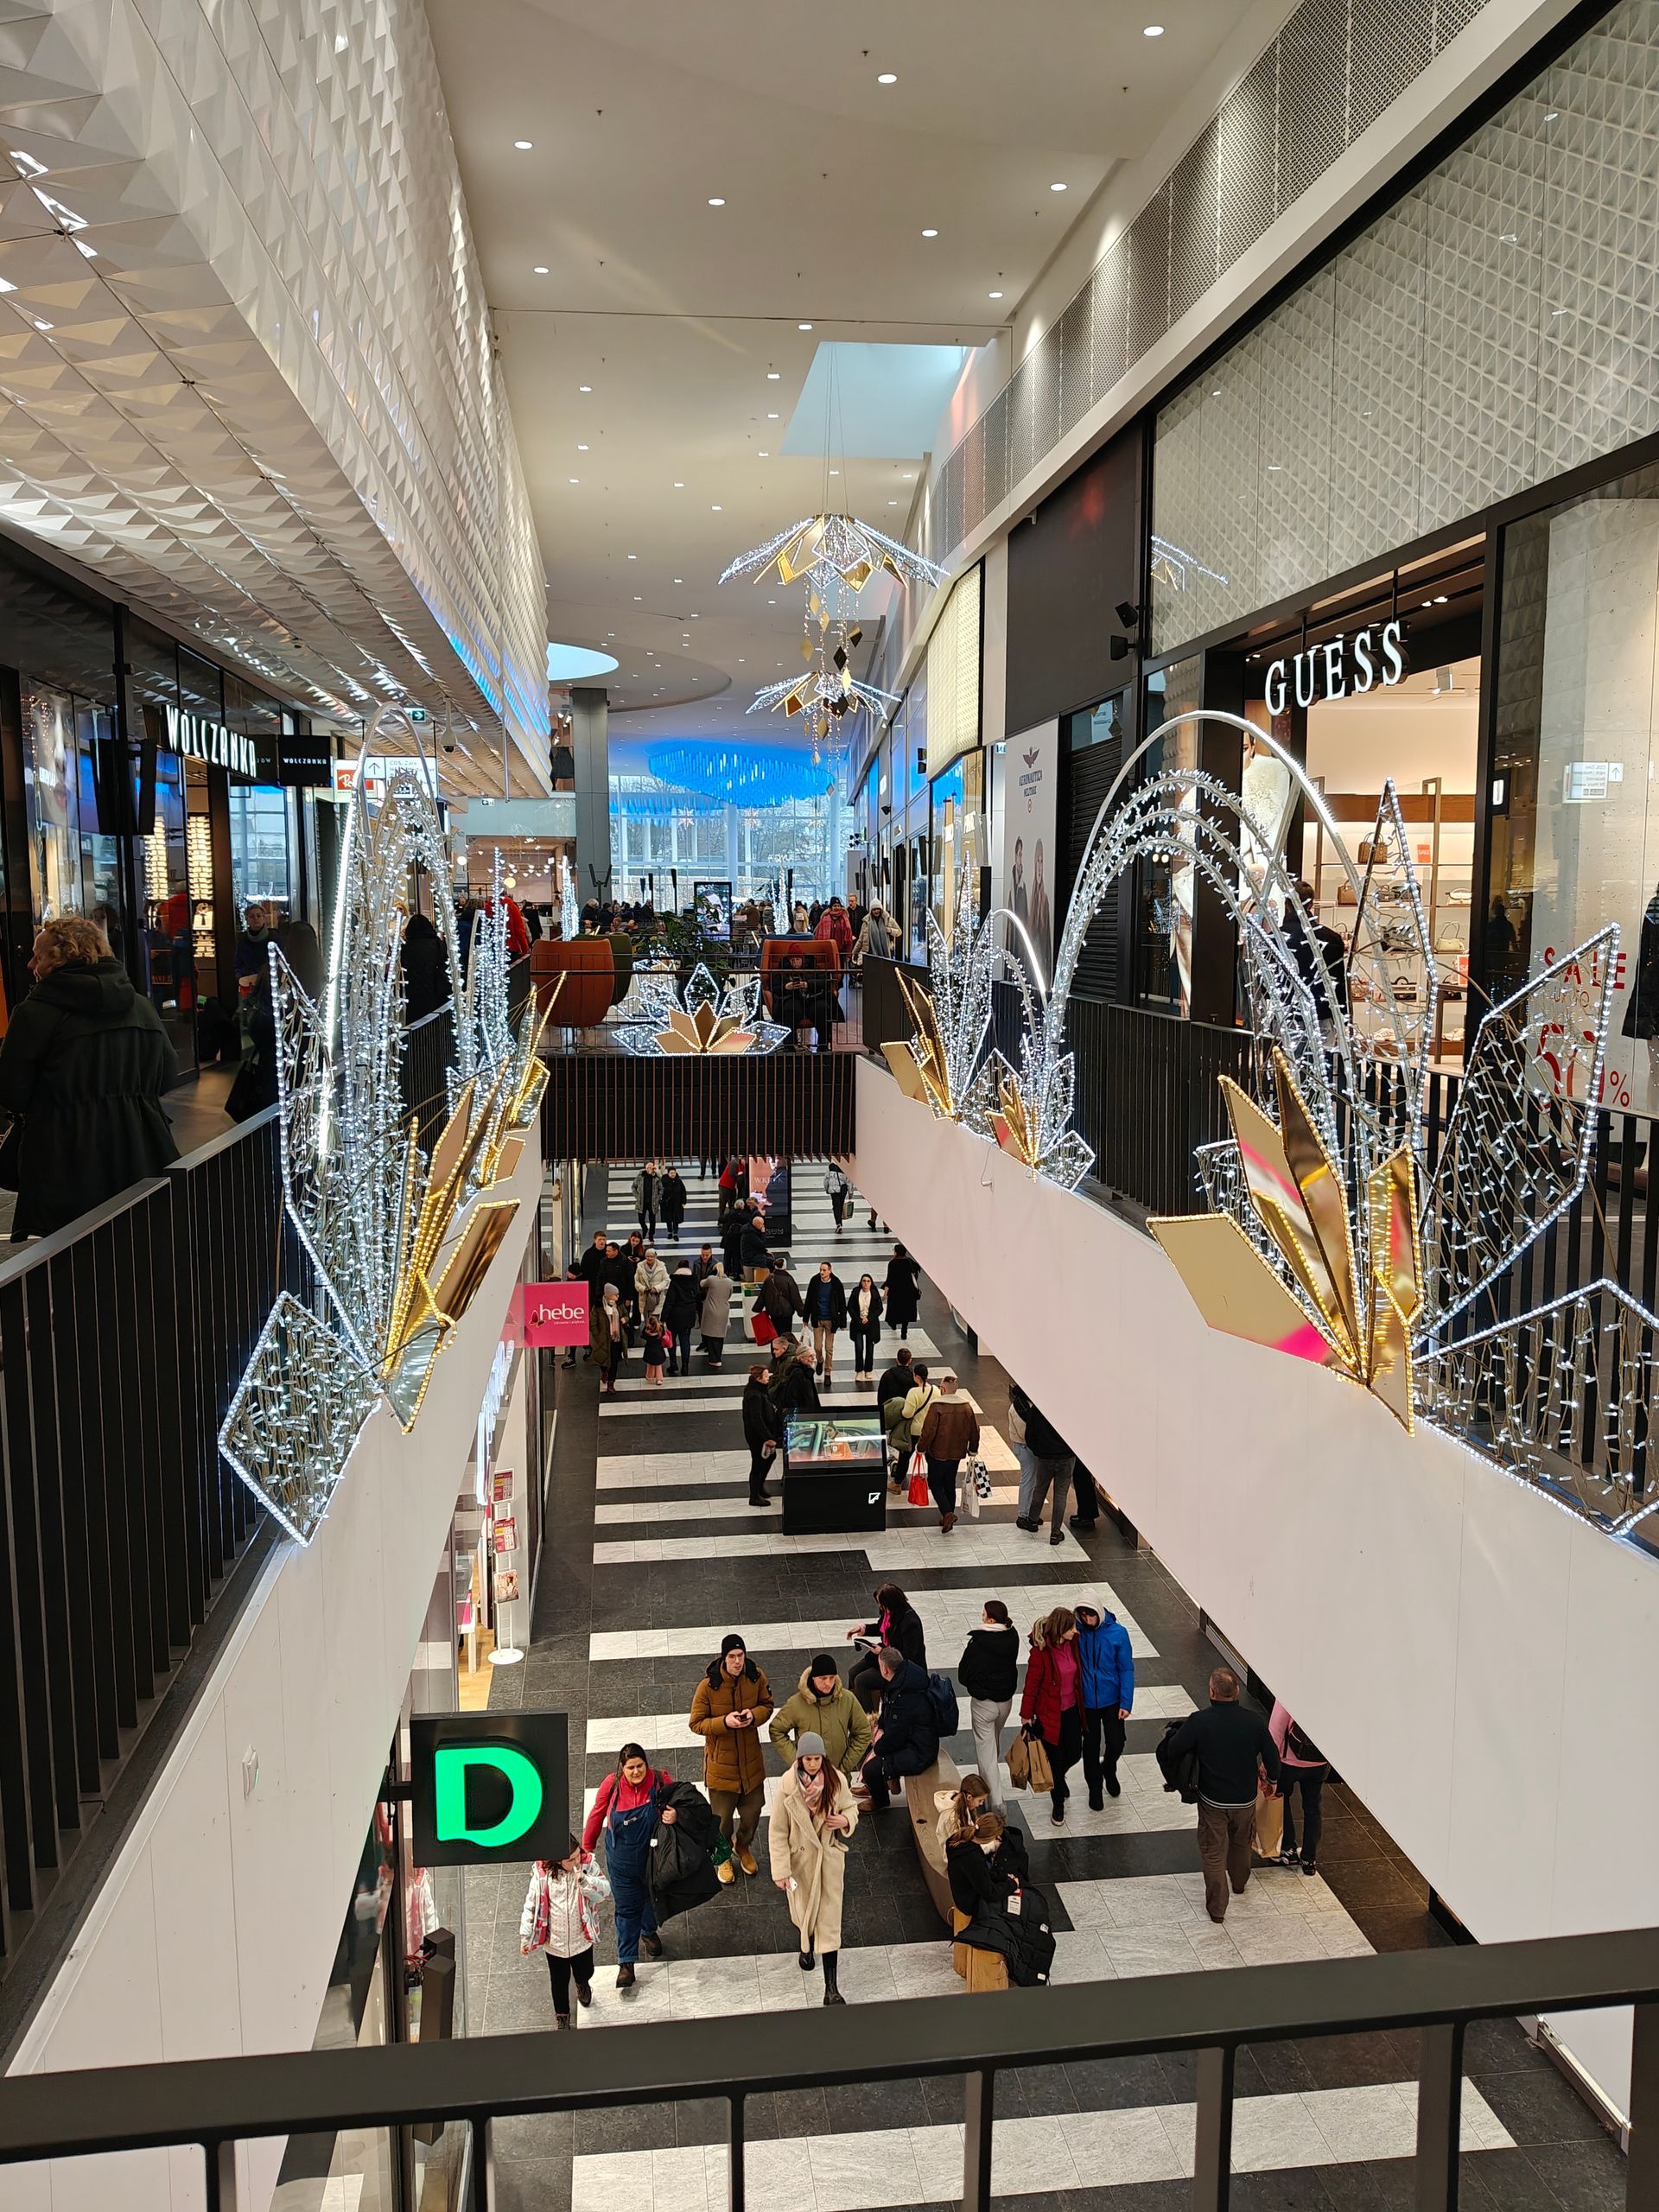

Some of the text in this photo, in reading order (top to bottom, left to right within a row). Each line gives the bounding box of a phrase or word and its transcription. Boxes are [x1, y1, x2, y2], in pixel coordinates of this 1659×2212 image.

[1265, 620, 1403, 716] GUESS
[539, 1302, 585, 1320] hebe
[435, 1745, 543, 1847] D
